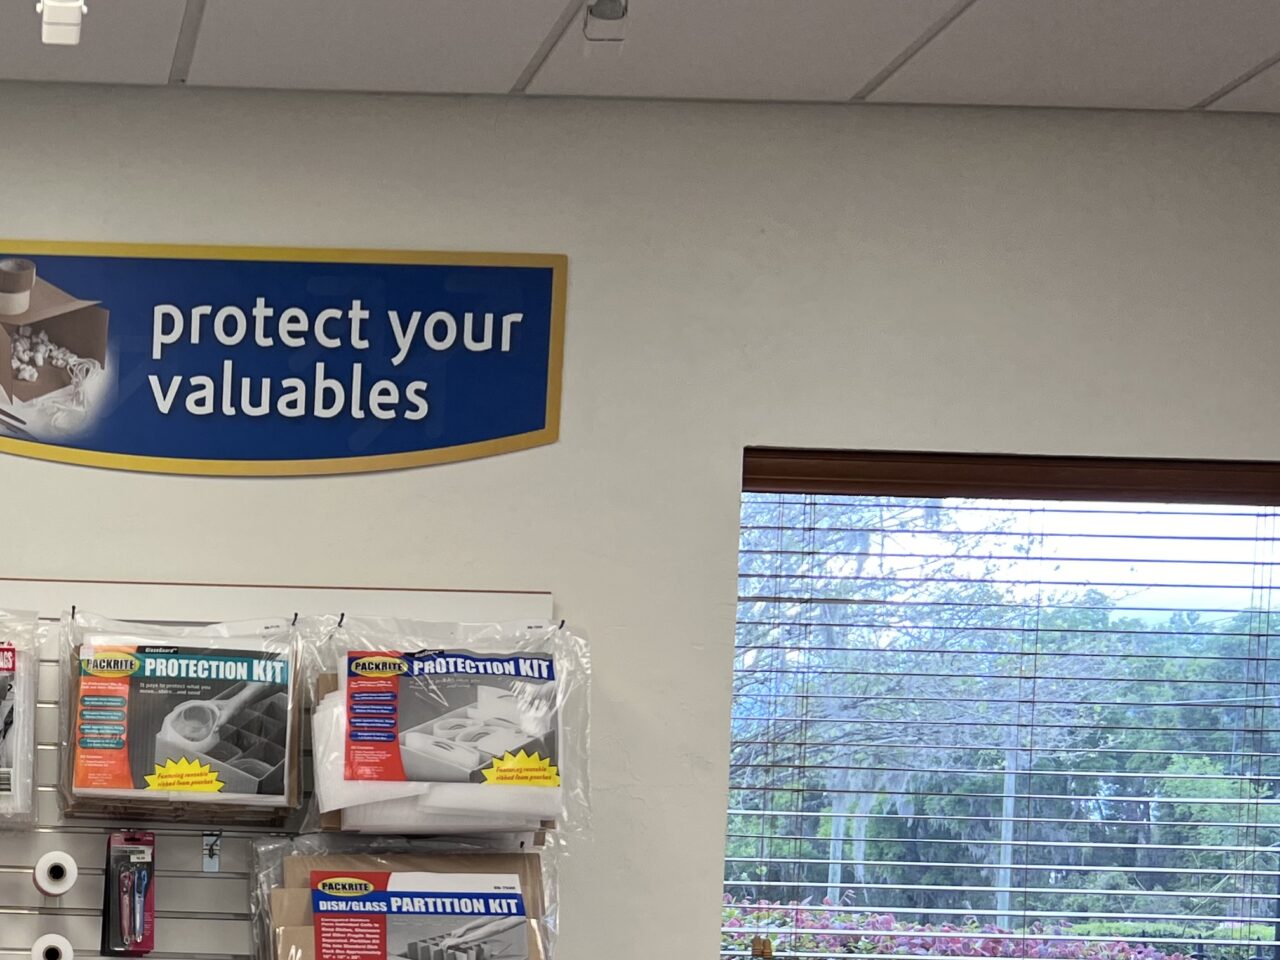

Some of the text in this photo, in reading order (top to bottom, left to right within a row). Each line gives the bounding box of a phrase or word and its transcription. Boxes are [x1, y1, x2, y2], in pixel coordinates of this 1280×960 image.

[152, 297, 523, 366] protect your
[148, 360, 428, 421] valuables
[86, 658, 135, 670] PACKRITE
[145, 657, 284, 684] PROTECTION KIT
[355, 661, 404, 672] PACKRITE
[413, 658, 550, 678] PROTECTION KIT
[322, 882, 369, 891] PACKRITE
[319, 897, 518, 914] DISH/GLASS PARTITION KIT
